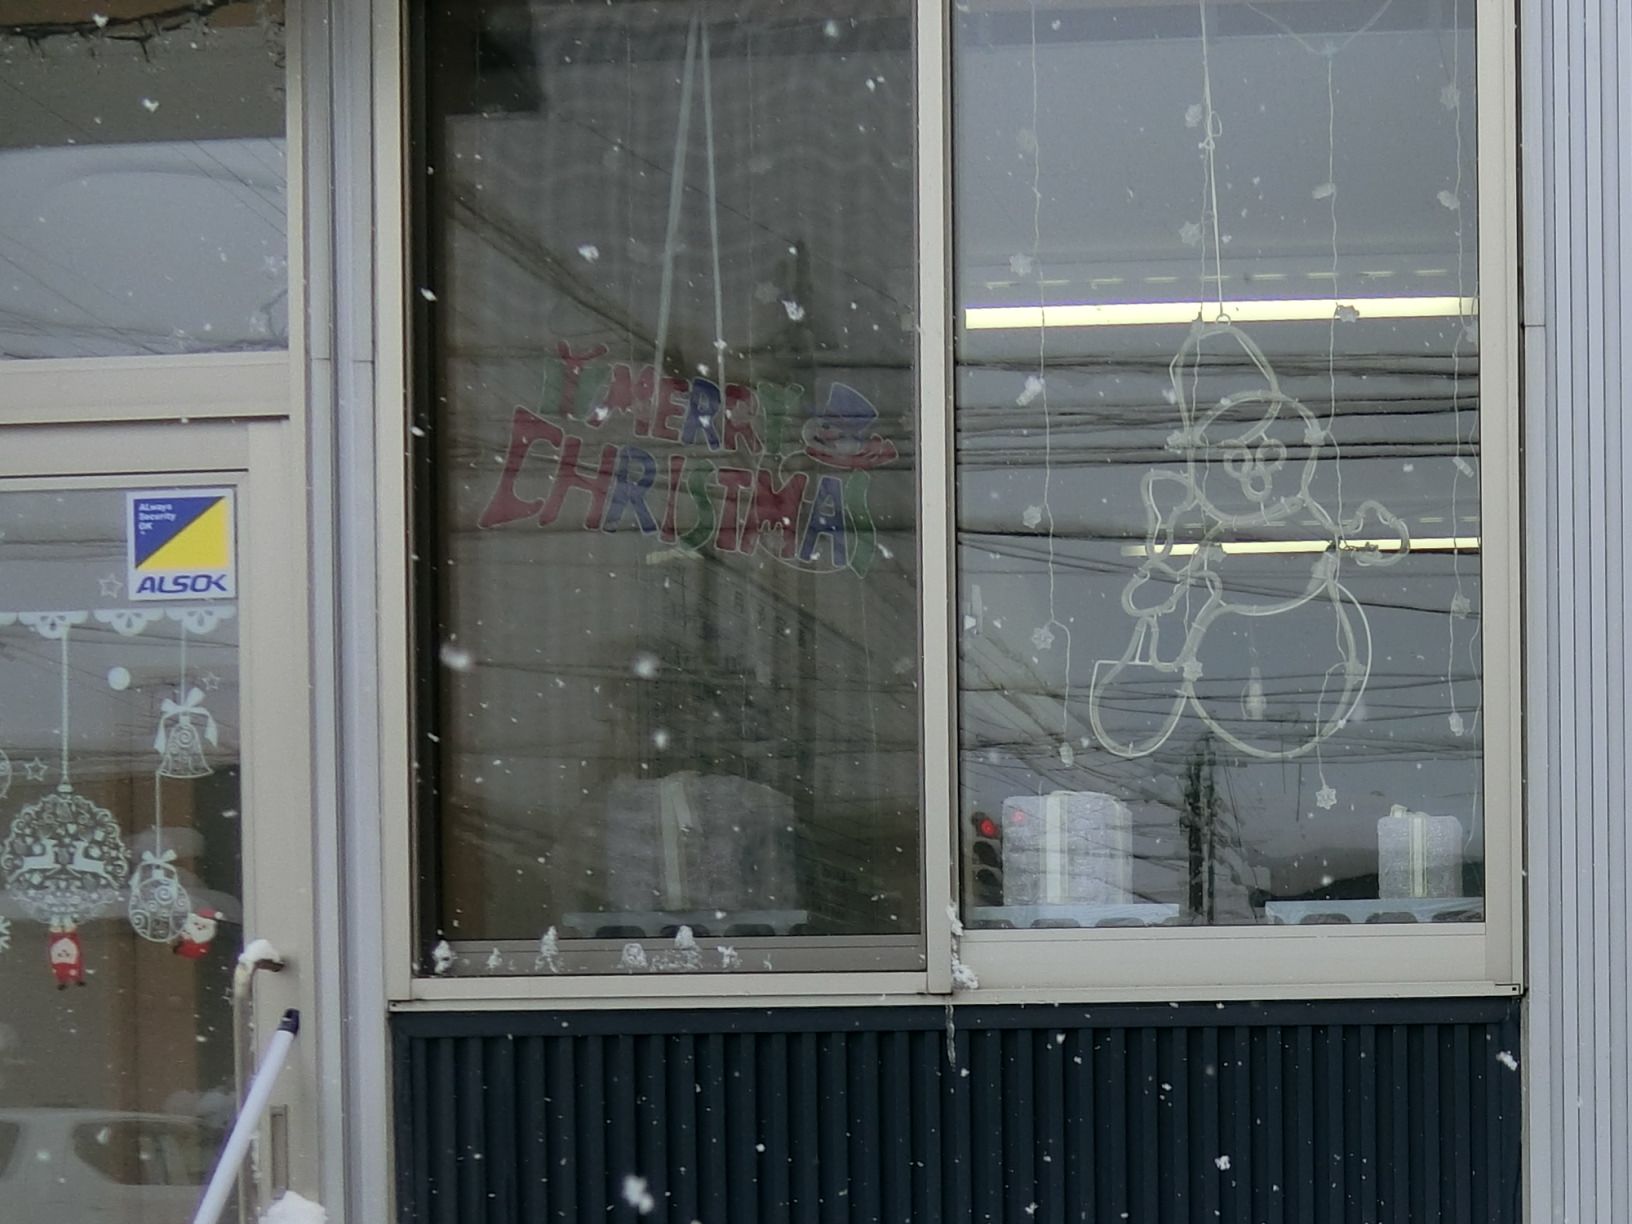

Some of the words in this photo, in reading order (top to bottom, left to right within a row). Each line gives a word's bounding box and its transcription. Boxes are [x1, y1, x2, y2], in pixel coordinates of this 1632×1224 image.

[586, 362, 805, 454] MERRY
[478, 405, 877, 579] CHRISTMAS
[138, 522, 153, 530] OK
[136, 573, 228, 594] ALSOK
